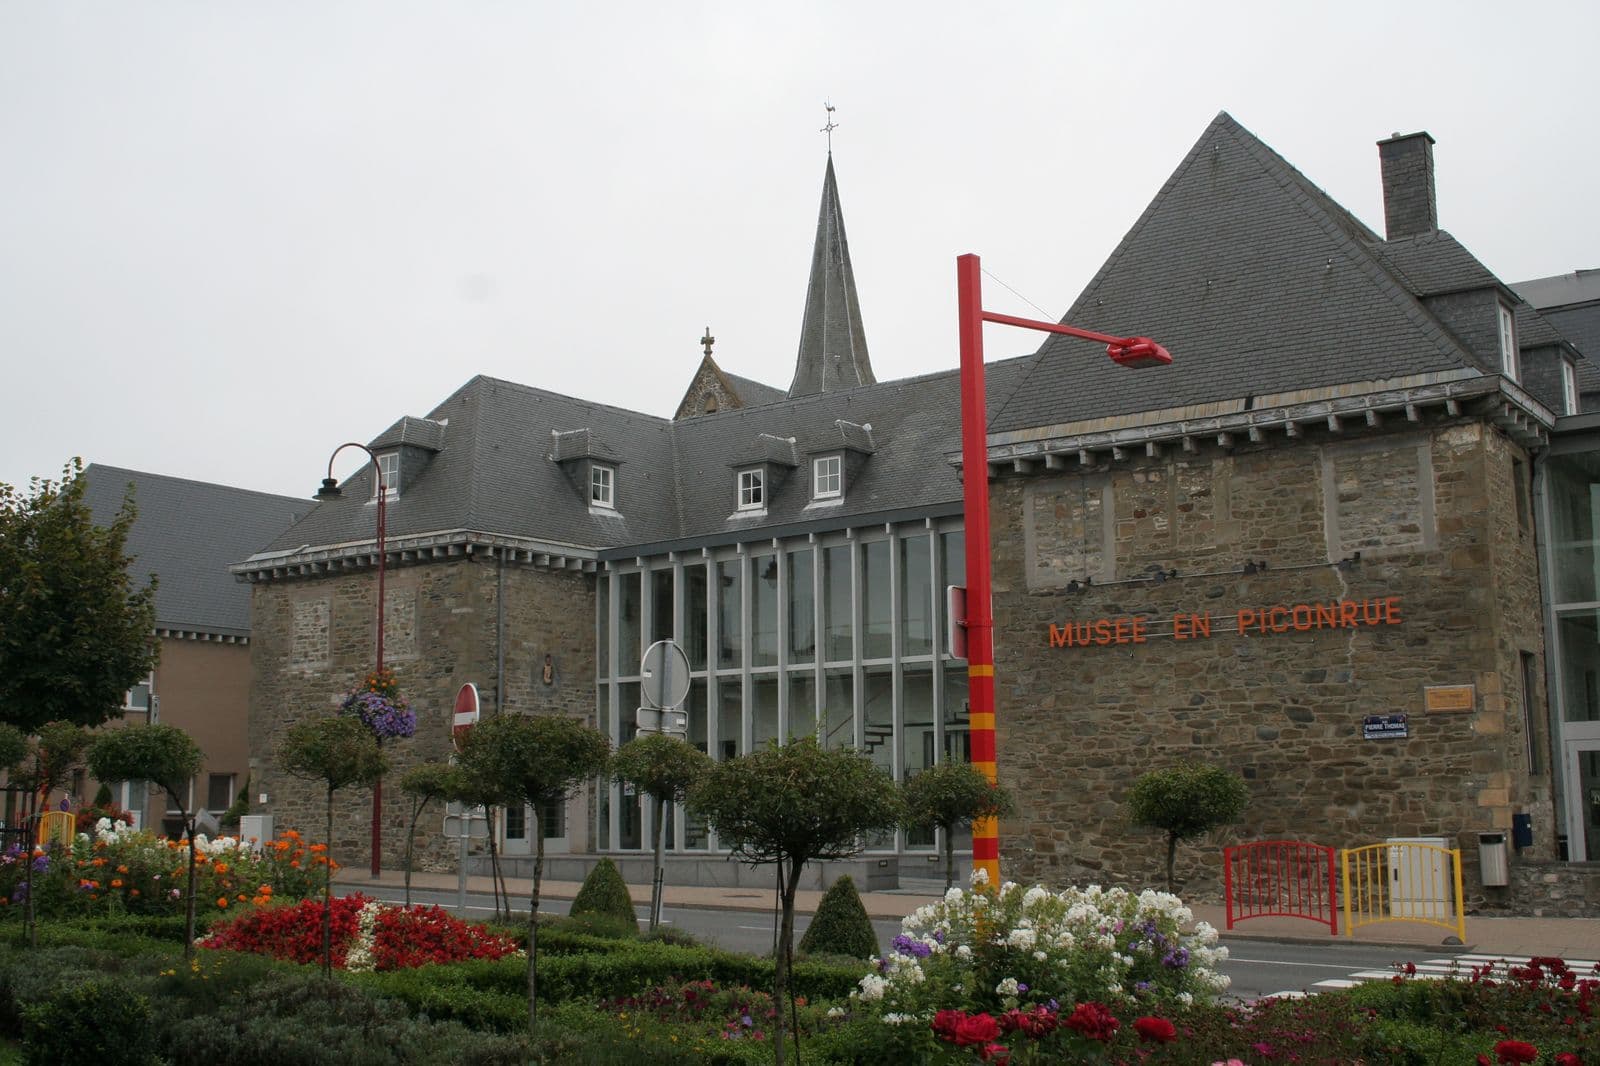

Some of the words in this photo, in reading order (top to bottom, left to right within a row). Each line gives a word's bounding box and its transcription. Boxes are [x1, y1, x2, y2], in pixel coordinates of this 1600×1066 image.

[1049, 617, 1147, 647] MUSEE
[1173, 610, 1211, 640] EN
[1237, 597, 1402, 636] PICONRUE
